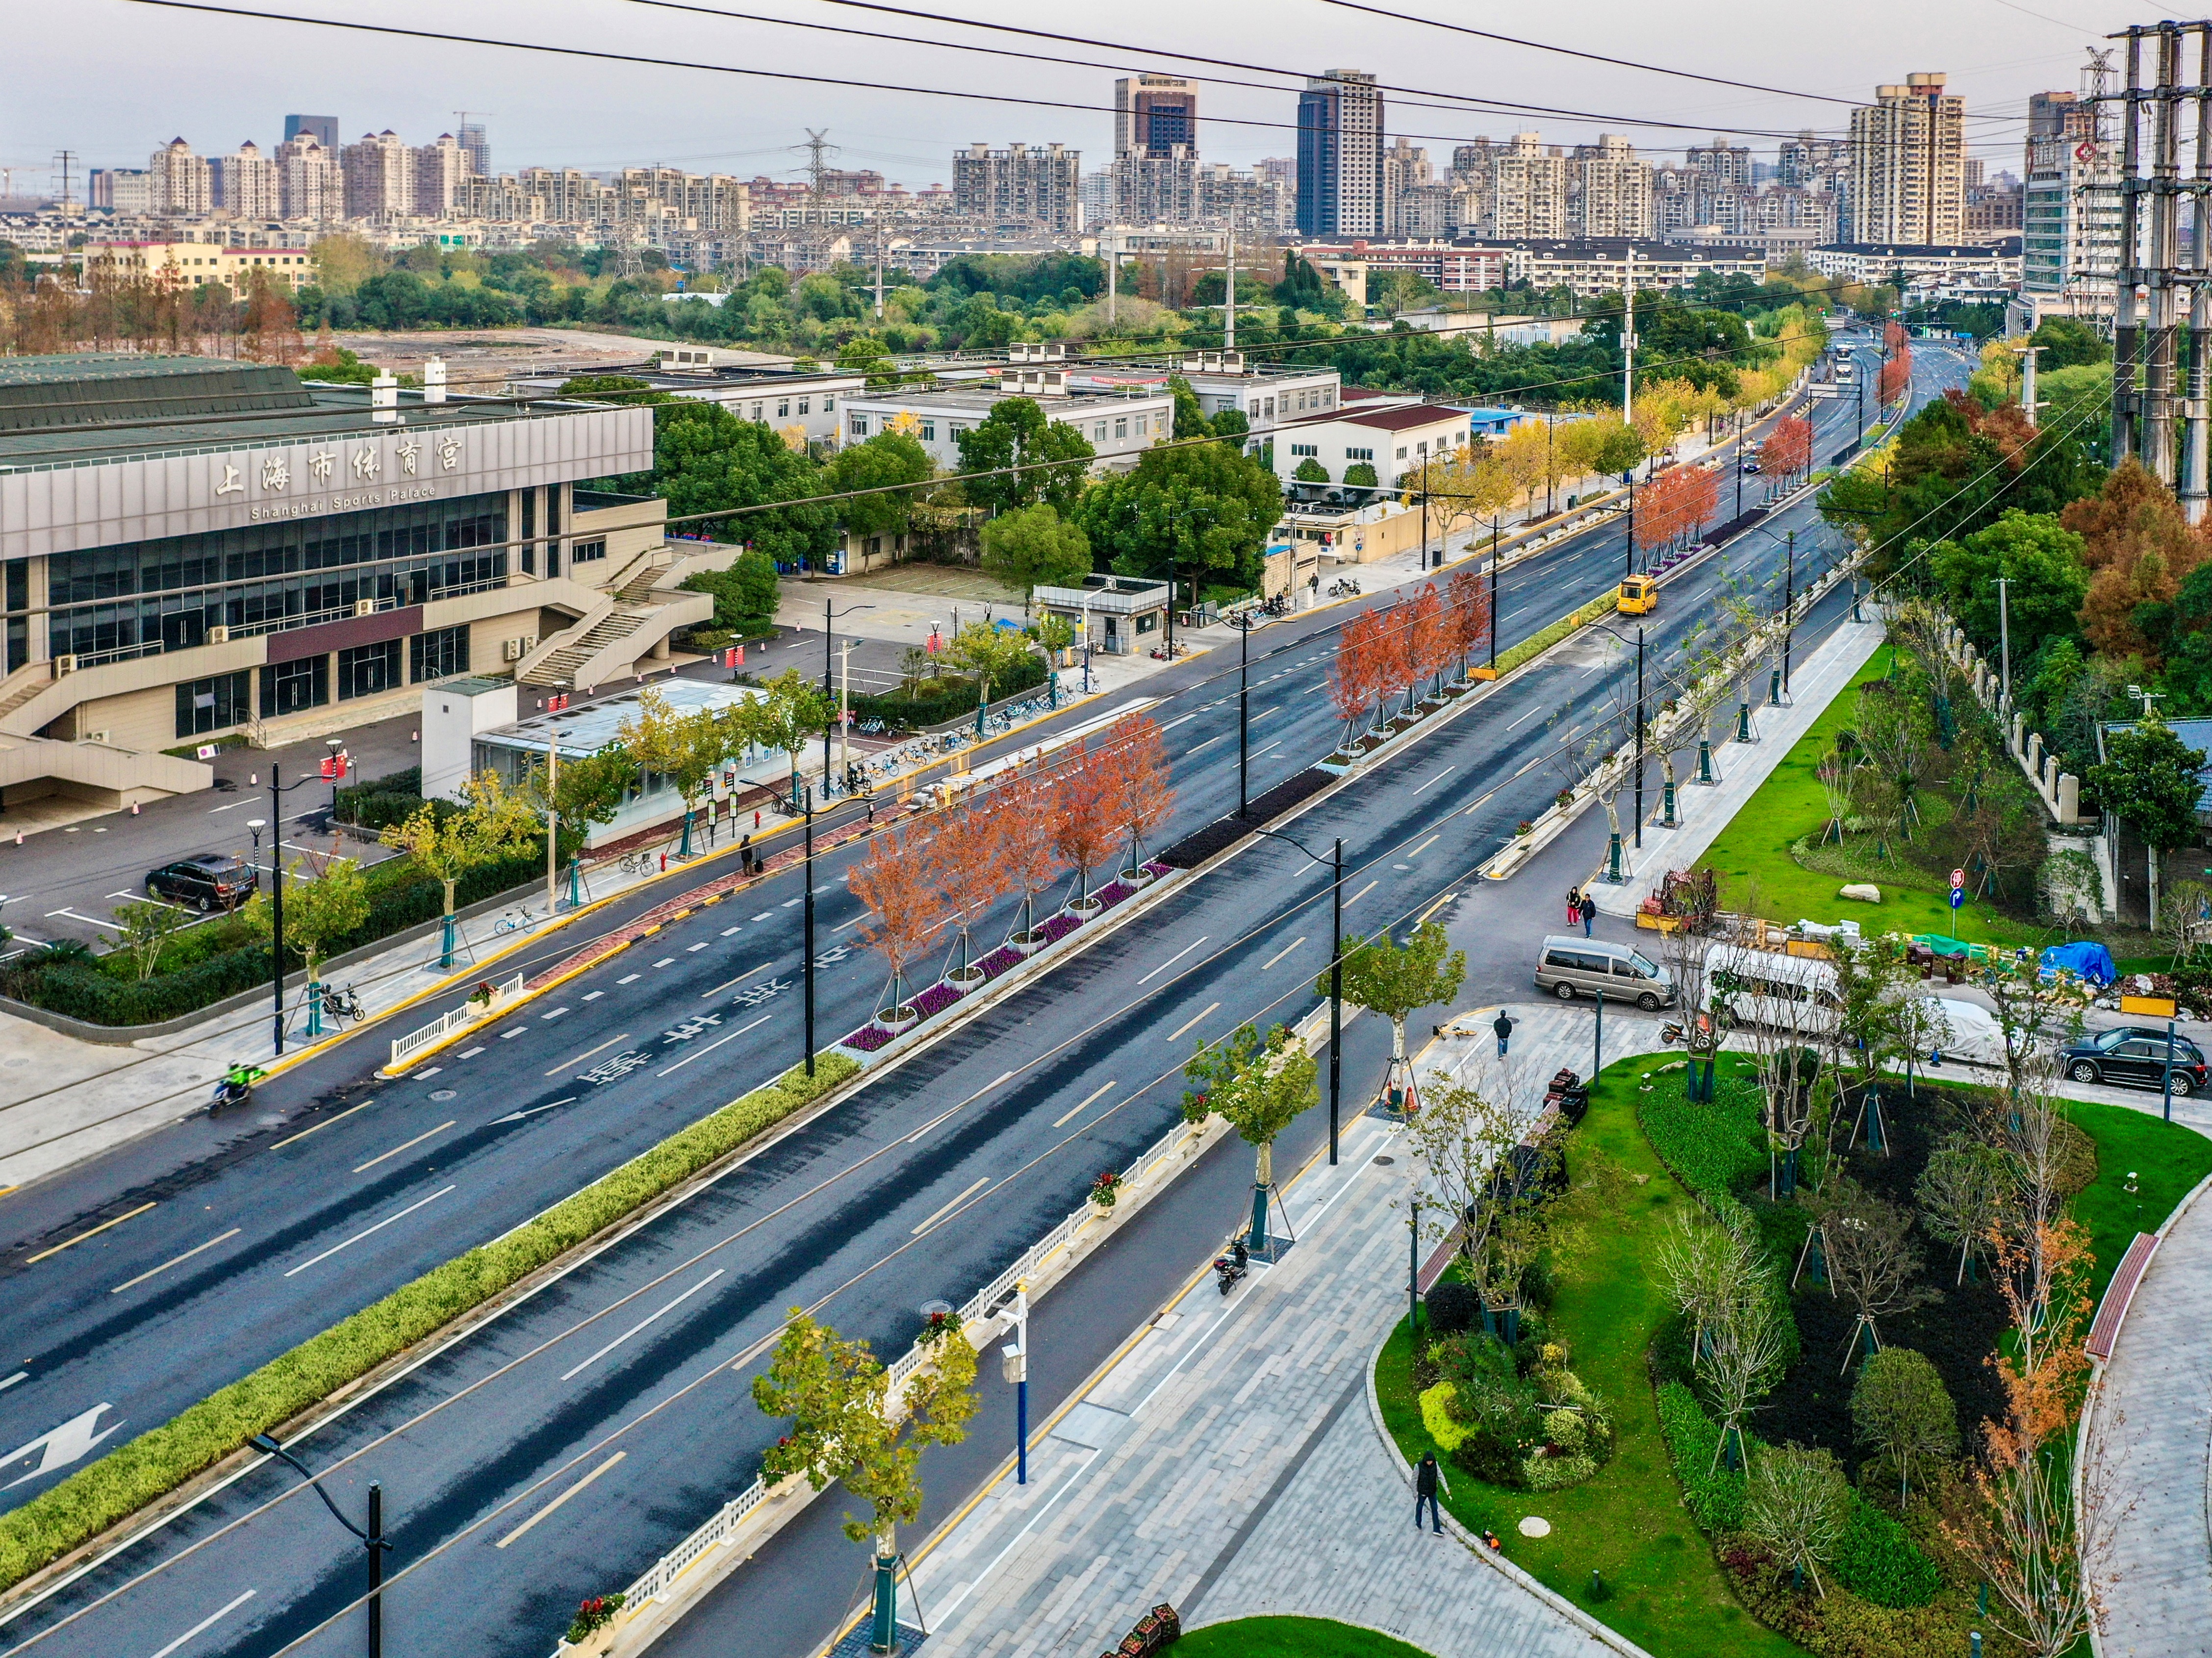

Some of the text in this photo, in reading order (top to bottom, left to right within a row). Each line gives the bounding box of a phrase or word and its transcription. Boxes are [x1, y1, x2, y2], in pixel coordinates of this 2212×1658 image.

[216, 437, 462, 496] 上海市体育宫
[251, 486, 436, 520] Shanghai Sports Palace
[1952, 872, 1962, 886] 停
